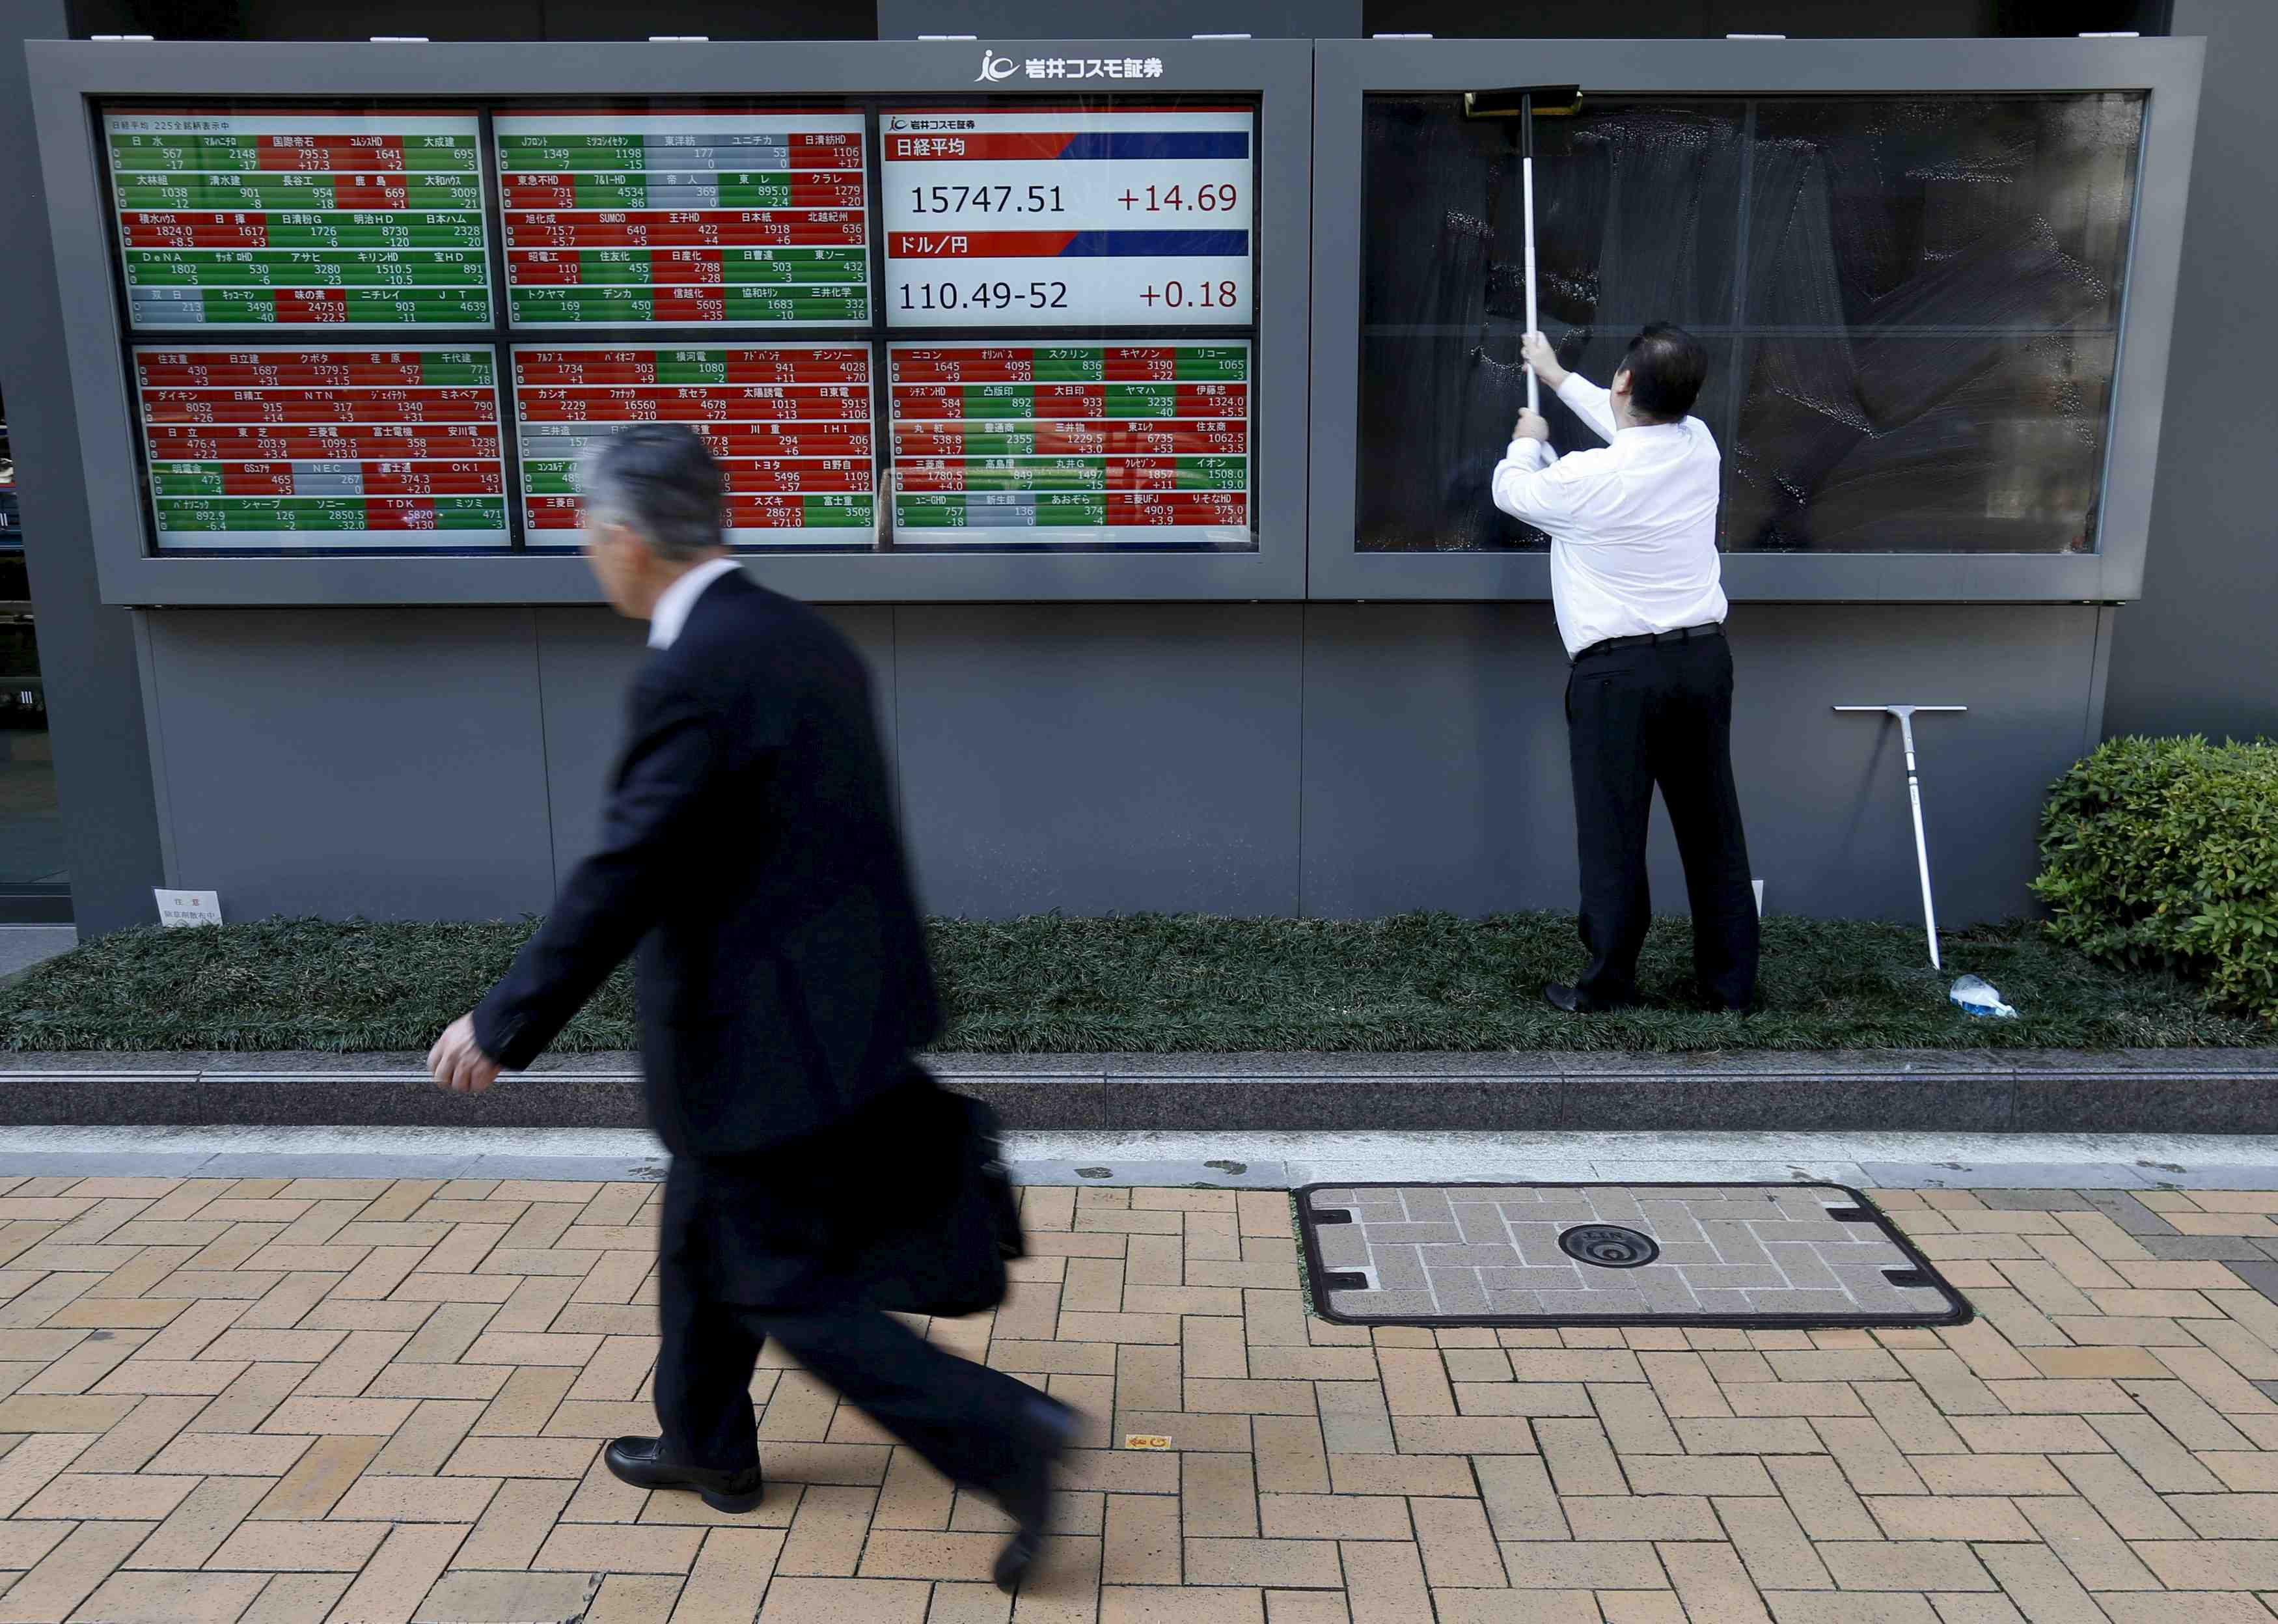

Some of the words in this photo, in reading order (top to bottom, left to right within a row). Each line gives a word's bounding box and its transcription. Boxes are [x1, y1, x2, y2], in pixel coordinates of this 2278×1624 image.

[1025, 57, 1163, 78] 岩井コスモ証券
[911, 120, 975, 130] 岩井コスモ証券
[272, 136, 314, 146] 国際帝石
[423, 136, 455, 146] 大成建
[805, 135, 846, 145] 日清紡HD
[897, 138, 965, 156] 日経平均
[543, 149, 570, 158] 1349
[615, 148, 642, 158] 1198
[832, 147, 859, 156] 1106
[297, 161, 330, 170] +17.3
[135, 175, 169, 185] 大林組
[208, 175, 241, 186] 清水建
[281, 175, 314, 186] 長谷工
[517, 175, 559, 186] 東急不HD
[811, 174, 842, 183] クラレ
[911, 186, 1065, 213] 15747.51
[1118, 184, 1237, 211] +14.69
[426, 214, 467, 223] 日本ハム
[525, 213, 556, 223] 旭化成
[598, 213, 626, 223] SUMCO
[668, 212, 700, 222] 王子HD
[741, 212, 772, 222] 日本紙
[155, 226, 193, 235] 1824.0
[238, 227, 265, 235] 1617
[310, 227, 337, 236] 1726
[381, 227, 409, 236] 8730
[453, 226, 480, 235] 2328
[544, 226, 575, 235] 715.7
[625, 225, 646, 234] 640
[697, 225, 719, 234] 422
[764, 225, 790, 233] 1918
[842, 224, 862, 233] 636
[168, 237, 195, 246] +8.5
[551, 237, 576, 246] +5.7
[290, 253, 321, 262] アサヒ
[357, 252, 399, 262] キリンHD
[599, 251, 631, 261] 住友化
[814, 249, 845, 260] 東ソー
[693, 262, 720, 271] 2788
[699, 273, 720, 282] +28
[294, 290, 326, 299] 味の素
[361, 290, 400, 299] ニチレイ
[528, 290, 566, 299] トクヤマ
[601, 288, 632, 298] デンカ
[811, 287, 852, 297] 三井化学
[899, 282, 1067, 309] 110.49-52
[1139, 281, 1237, 307] +0.18
[246, 302, 273, 311] 3490
[307, 302, 344, 311] 2475.0
[394, 302, 415, 310] 903
[459, 301, 486, 310] 4639
[696, 300, 722, 309] 5605
[767, 299, 793, 309] 1683
[313, 312, 346, 322] +22.5
[702, 310, 723, 320] +35
[229, 354, 260, 363] 日立建
[299, 353, 329, 363] クボタ
[812, 350, 853, 359] デンソー
[1049, 349, 1089, 359] スクリン
[1119, 349, 1160, 358] キヤノン
[1197, 348, 1227, 357] リコー
[186, 366, 208, 375] 430
[252, 366, 279, 375] 1687
[312, 366, 349, 374] 1379.5
[398, 365, 420, 374] 457
[469, 365, 490, 373] 771
[557, 364, 584, 373] 1734
[698, 363, 724, 372] 1080
[839, 363, 866, 371] 4028
[934, 362, 959, 370] 1645
[1004, 361, 1031, 370] 4095
[1082, 361, 1103, 370] 836
[1146, 361, 1173, 369] 3190
[1218, 360, 1244, 369] 1065
[158, 391, 198, 400] ダイキン
[440, 390, 479, 399] ミネベア
[538, 389, 568, 398] カシオ
[678, 388, 707, 398] 京セラ
[819, 387, 849, 397] 日東電
[983, 386, 1013, 396] 凸版印
[1054, 385, 1084, 395] 大日印
[1125, 385, 1155, 394] ヤマハ
[560, 401, 586, 409] 2229
[624, 400, 656, 409] 16560
[700, 400, 726, 409] 4678
[771, 400, 797, 408] 1013
[841, 399, 867, 408] 5915
[941, 398, 961, 407] 584
[1011, 398, 1032, 407] 892
[1082, 398, 1102, 406] 933
[1147, 397, 1173, 406] 3235
[1208, 397, 1244, 406] 1324.0
[629, 411, 657, 420] +210
[840, 409, 868, 419] +106
[1219, 407, 1244, 416] +5.5
[1196, 421, 1226, 431] 住友商
[307, 426, 338, 437] 三菱電
[447, 426, 478, 435] 安川電
[186, 439, 217, 448] 476.4
[256, 439, 287, 448] 203.9
[320, 439, 357, 447] 1099.5
[406, 438, 427, 447] 358
[470, 438, 497, 447] 1238
[932, 435, 962, 444] 538.8
[262, 449, 288, 458] +3.4
[327, 449, 358, 458] +13.0
[754, 460, 780, 469] トヨタ
[822, 460, 851, 469] 日野自
[1196, 458, 1226, 467] イオン
[774, 472, 800, 481] 5496
[241, 499, 282, 508] シャープ
[455, 499, 483, 507] ミツミ
[754, 496, 784, 506] スズキ
[1192, 494, 1231, 503] りそなHD
[765, 508, 801, 516] 2867.5
[1144, 506, 1173, 514] 490.9
[771, 518, 802, 527] +71.0
